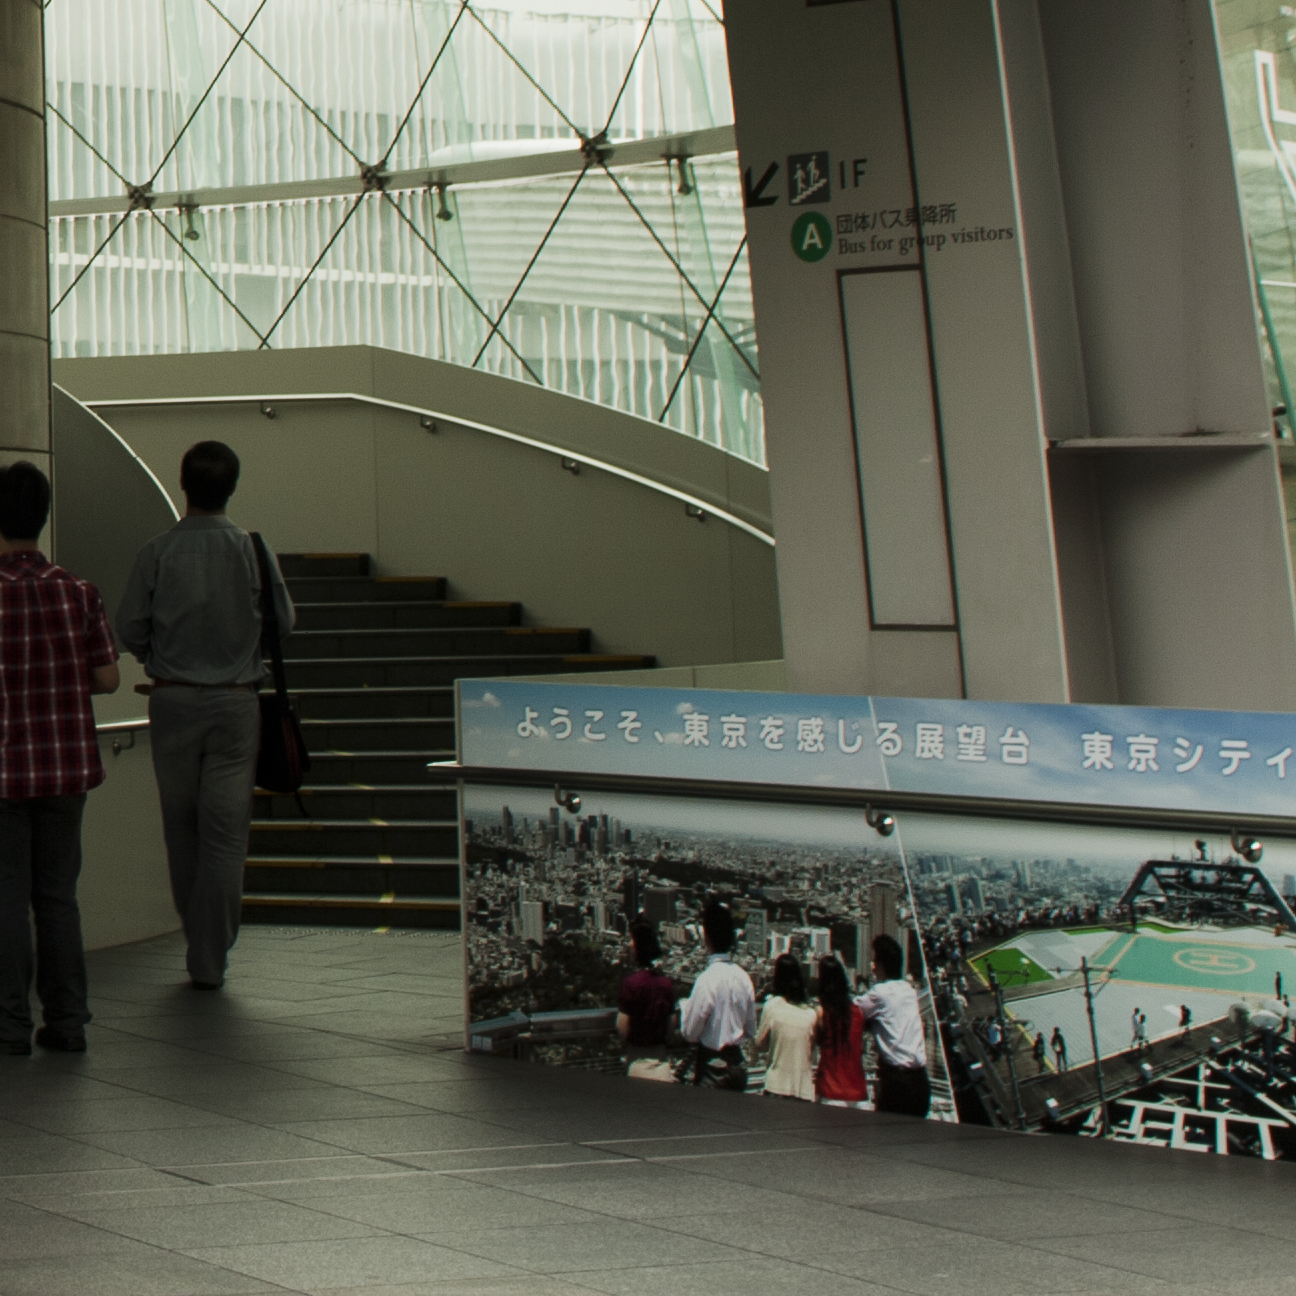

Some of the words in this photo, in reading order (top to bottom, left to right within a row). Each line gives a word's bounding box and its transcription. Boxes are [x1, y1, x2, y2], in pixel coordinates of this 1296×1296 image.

[835, 203, 957, 235] 団体バス乗降所
[802, 222, 824, 251] A
[838, 236, 866, 255] Bus
[870, 234, 894, 252] for
[898, 232, 947, 257] group
[950, 224, 1014, 244] visitors
[517, 706, 1031, 765] ようこそ、東京を感じる展望台
[1080, 731, 1293, 779] 東京シティ
